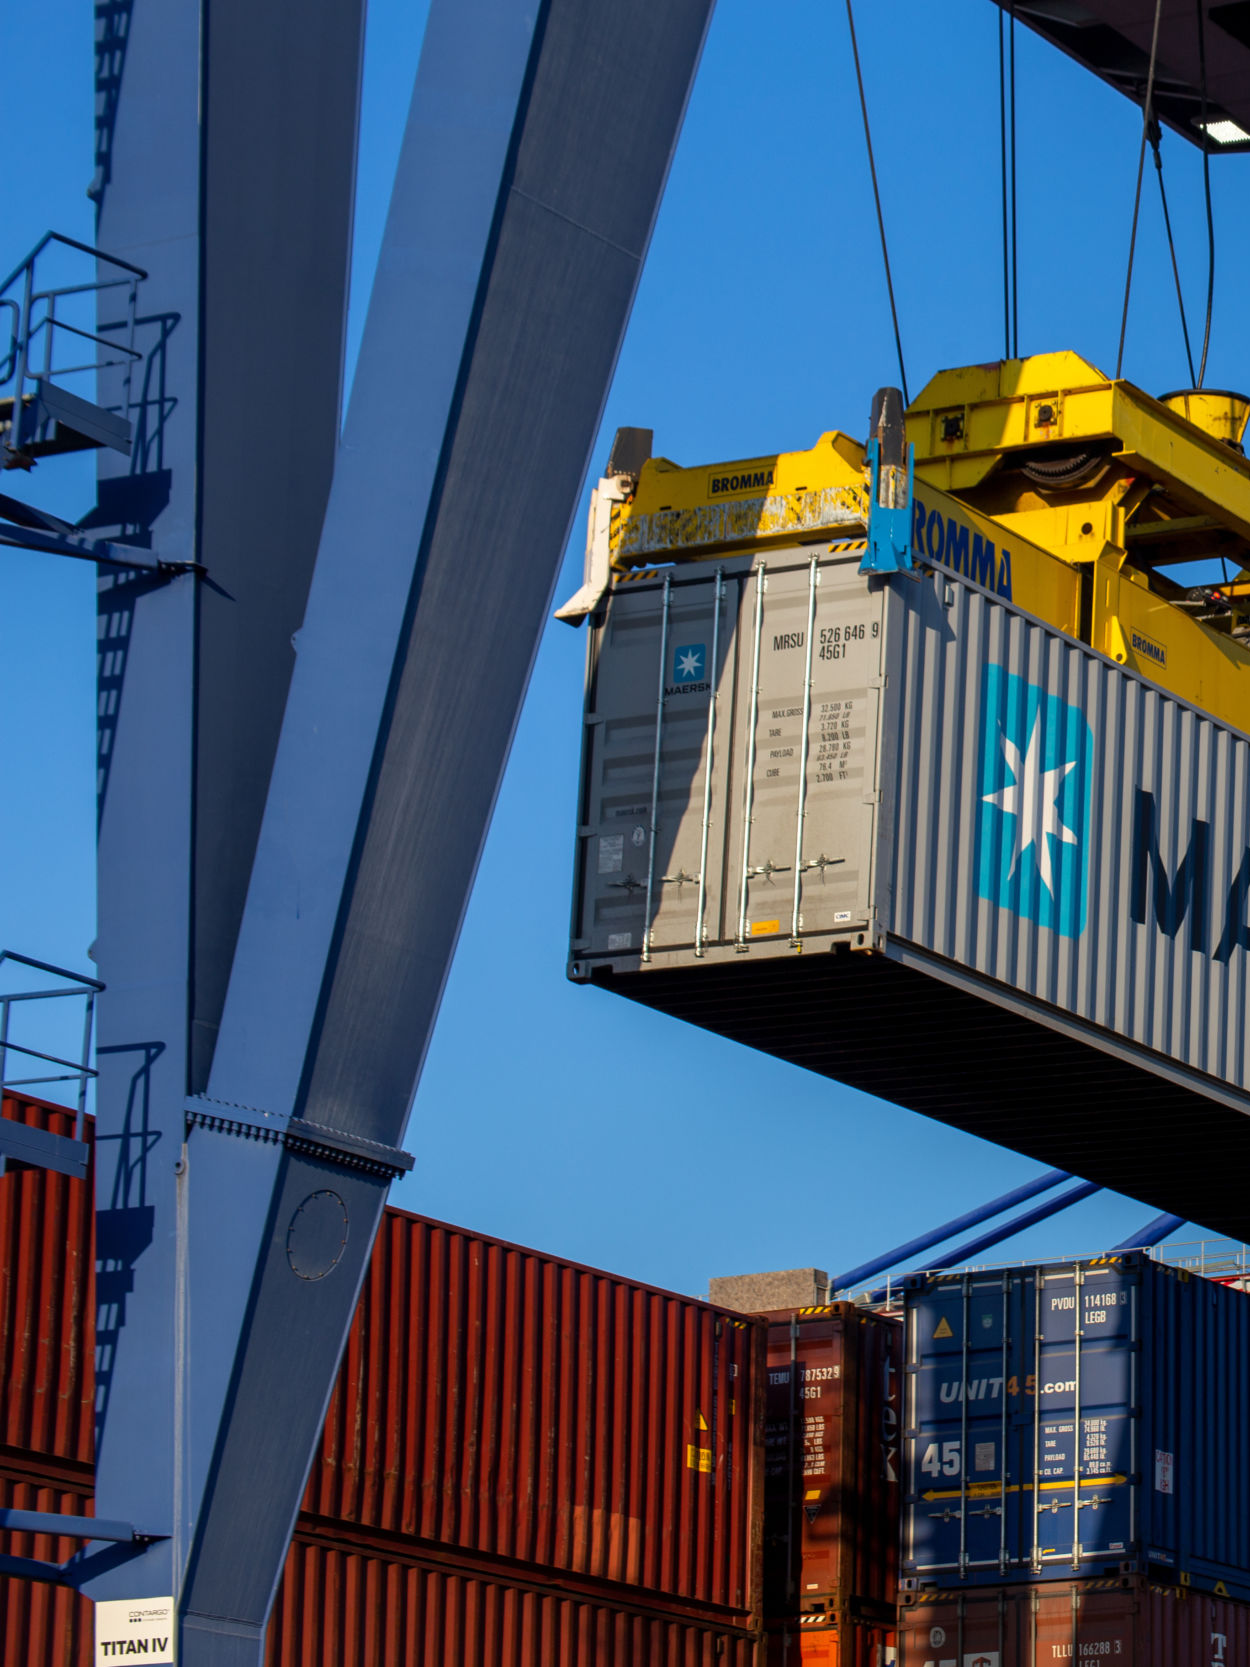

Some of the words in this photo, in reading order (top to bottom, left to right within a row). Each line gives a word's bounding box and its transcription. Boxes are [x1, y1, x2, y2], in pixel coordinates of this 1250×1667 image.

[712, 471, 774, 493] BROMMA
[911, 497, 1012, 603] ROMMA
[773, 632, 804, 651] MRSU
[820, 627, 841, 644] 526
[844, 624, 865, 641] 646
[871, 621, 880, 639] 9
[819, 643, 846, 660] 45G1
[1132, 633, 1165, 665] BROMMA
[844, 701, 853, 710] KG
[841, 720, 849, 729] KG
[842, 741, 851, 750] KG
[1051, 1297, 1075, 1311] PVDU
[1084, 1293, 1117, 1308] 114168
[1084, 1310, 1106, 1324] LEGB
[768, 1372, 790, 1385] TEMU
[800, 1386, 821, 1399] 45G1
[921, 1441, 961, 1478] 45
[129, 1609, 168, 1618] CONTARGO
[101, 1639, 148, 1656] TITAN
[152, 1637, 168, 1652] IV
[1052, 1644, 1073, 1658] TLLU
[1079, 1641, 1111, 1656] 166288
[1114, 1640, 1121, 1654] 3
